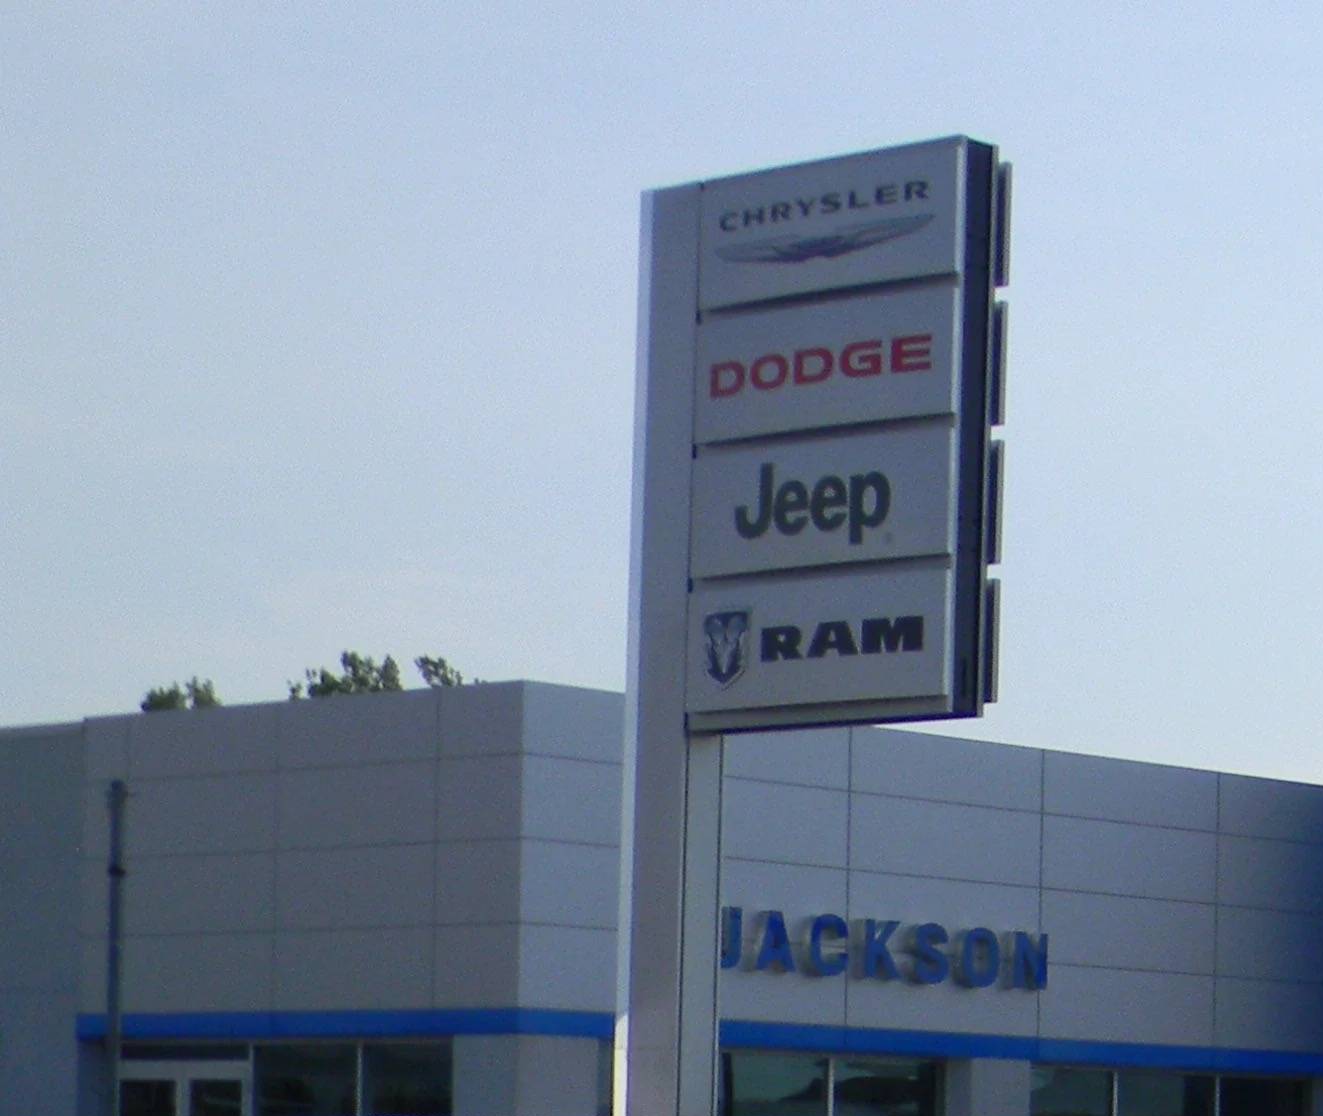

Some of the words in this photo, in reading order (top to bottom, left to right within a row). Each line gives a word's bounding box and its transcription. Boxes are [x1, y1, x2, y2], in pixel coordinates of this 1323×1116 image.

[719, 180, 930, 233] CHRYSLER
[709, 333, 933, 399] DODGE
[734, 462, 891, 545] Jeep
[760, 615, 924, 663] RAM
